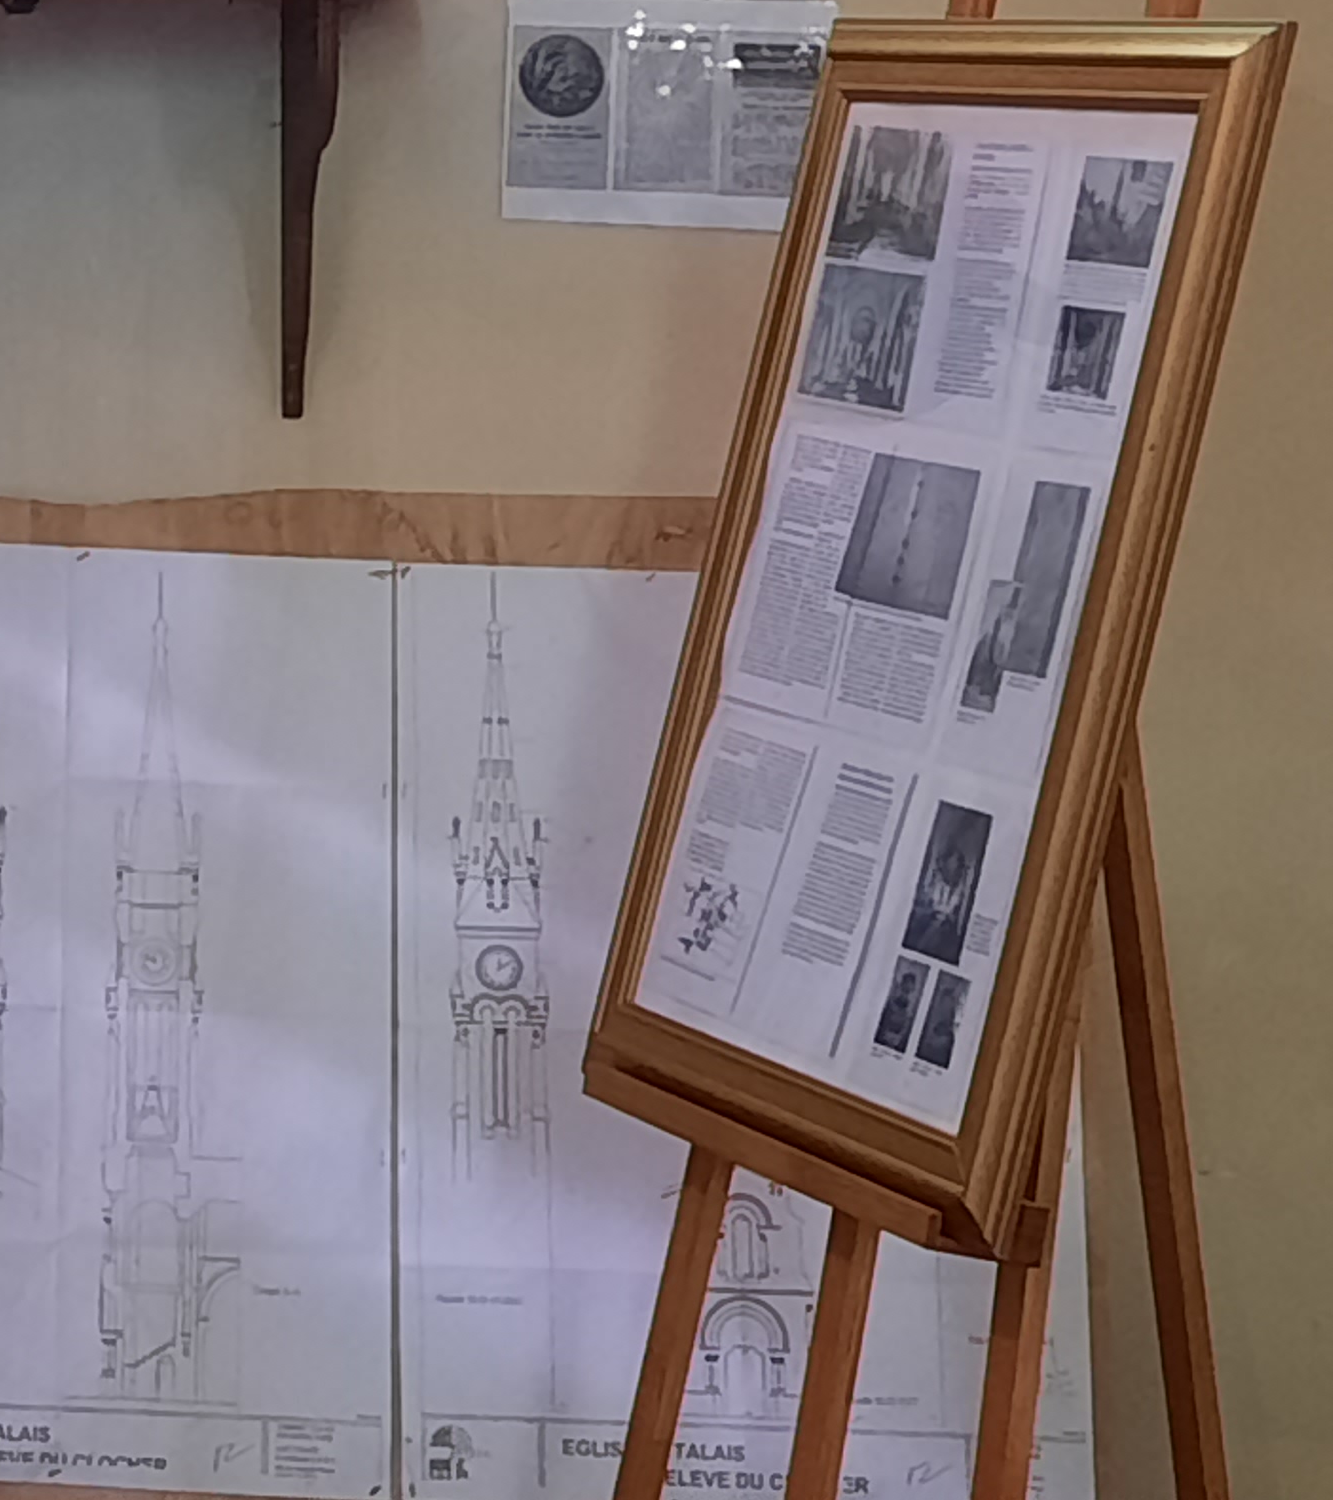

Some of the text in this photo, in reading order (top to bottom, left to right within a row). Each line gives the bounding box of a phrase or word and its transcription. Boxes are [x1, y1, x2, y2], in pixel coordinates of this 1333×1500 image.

[561, 1438, 746, 1463] EGLIS TALAIS
[665, 1468, 731, 1489] ELEVE
[735, 1471, 764, 1491] DU
